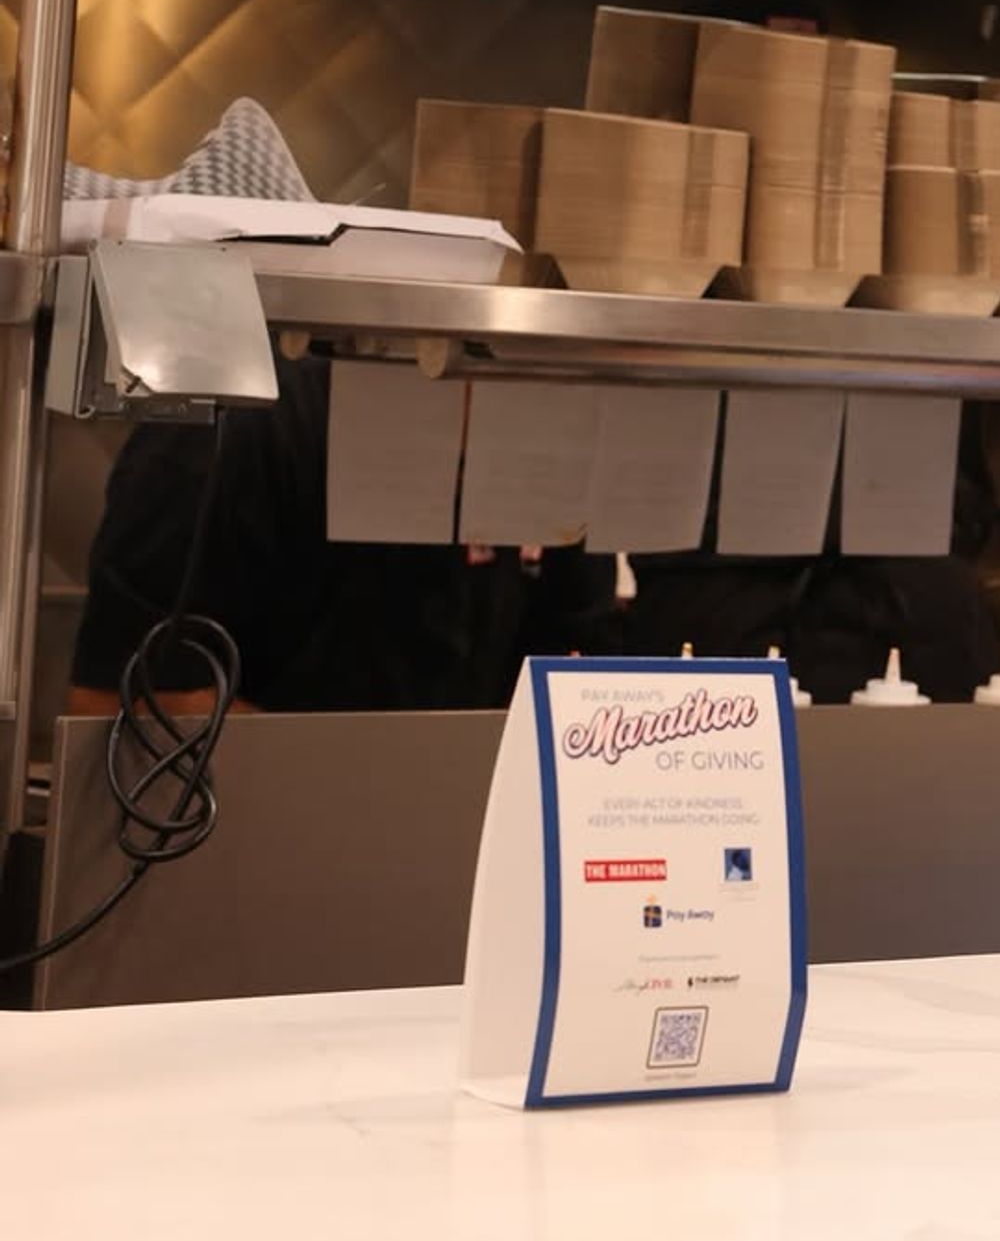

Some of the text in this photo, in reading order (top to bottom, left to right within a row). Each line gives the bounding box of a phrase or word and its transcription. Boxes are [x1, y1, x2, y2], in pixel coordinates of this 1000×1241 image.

[581, 688, 609, 703] PAY
[563, 688, 757, 764] Marathon
[656, 749, 765, 771] OF GIVING
[586, 863, 667, 879] THE MARATHON
